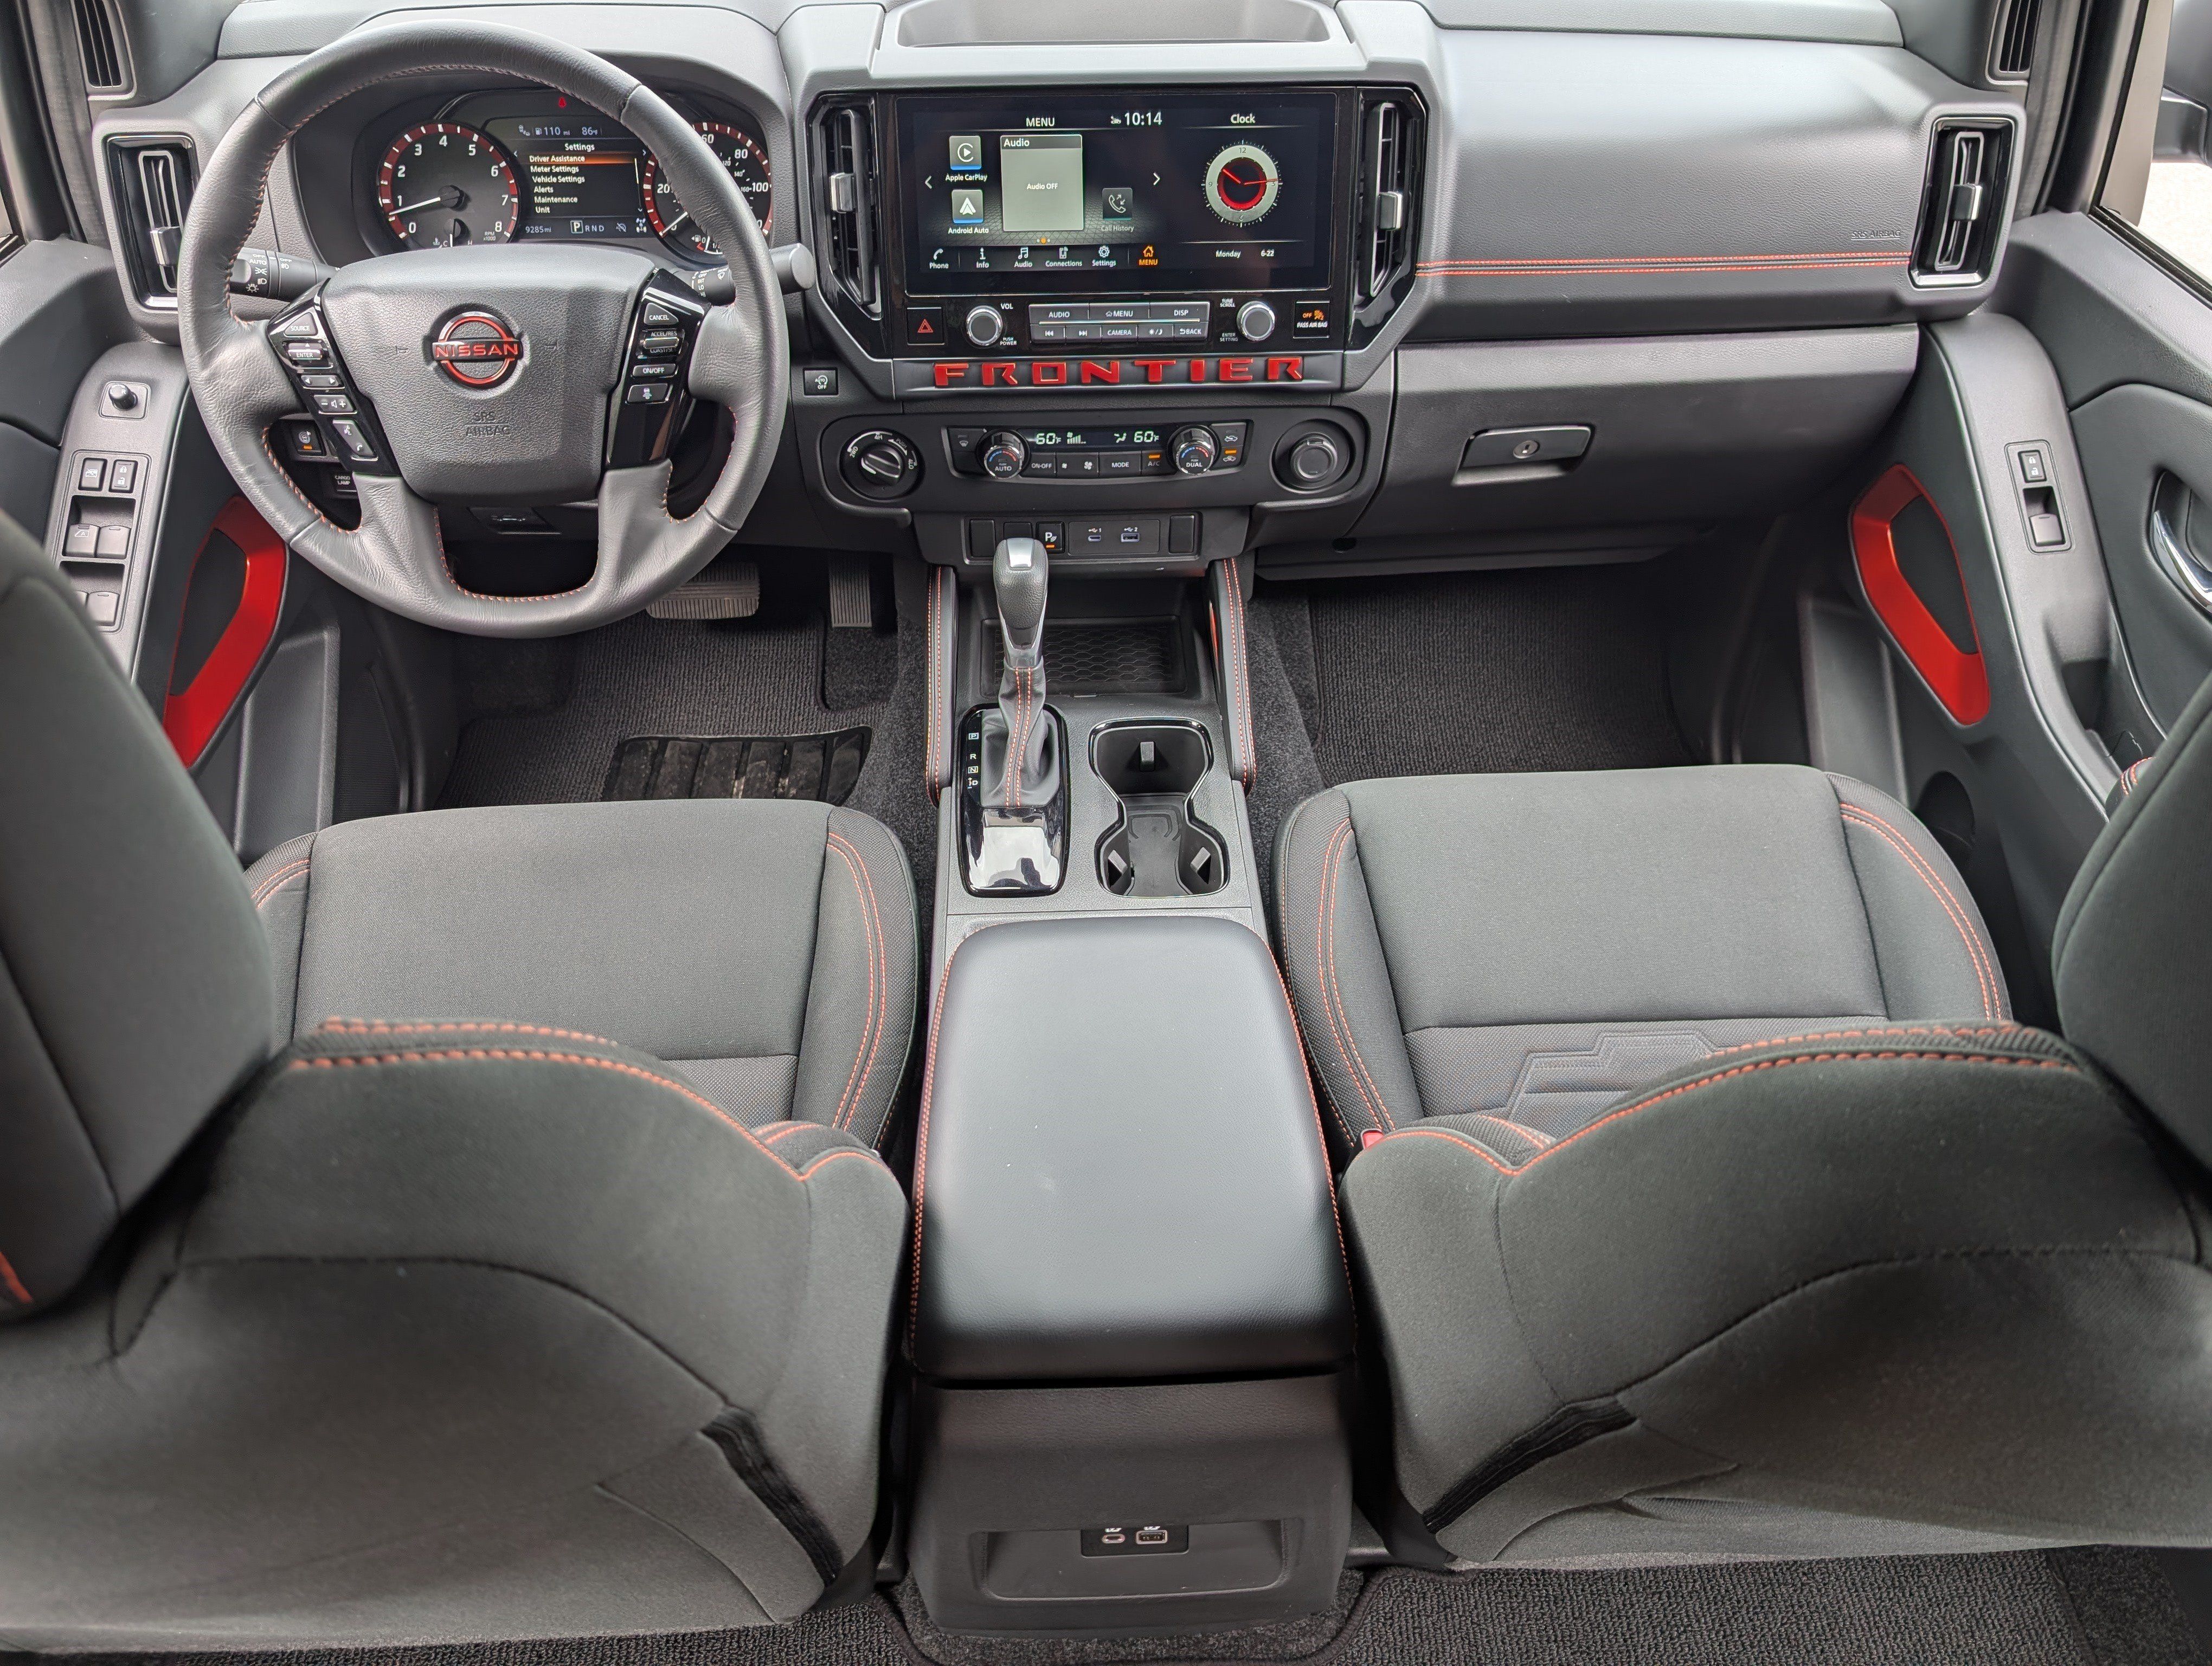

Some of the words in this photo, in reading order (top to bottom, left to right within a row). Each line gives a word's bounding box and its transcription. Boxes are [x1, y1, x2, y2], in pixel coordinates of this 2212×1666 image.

[1026, 118, 1055, 127] MENU
[1124, 112, 1162, 126] 10:14
[1230, 113, 1256, 124] Clock
[544, 127, 561, 136] 110
[439, 135, 447, 147] 4
[702, 134, 714, 144] 60
[1004, 138, 1030, 147] Audio
[414, 144, 422, 156] 3
[468, 144, 476, 156] 5
[564, 143, 595, 152] Settings
[735, 149, 748, 159] 80
[397, 165, 406, 177] 2
[491, 165, 498, 177] 6
[558, 176, 585, 184] Settings
[657, 183, 670, 194] 20
[752, 182, 769, 192] 100
[397, 195, 402, 207] 1
[501, 194, 508, 206] 7
[408, 222, 416, 233] 0
[495, 221, 502, 232] 8
[1216, 249, 1241, 259] Monday
[1092, 259, 1116, 267] Settings
[435, 343, 518, 357] NISSAN
[934, 358, 1303, 386] FRONTIER
[474, 411, 496, 421] SRS
[1045, 532, 1052, 542] P
